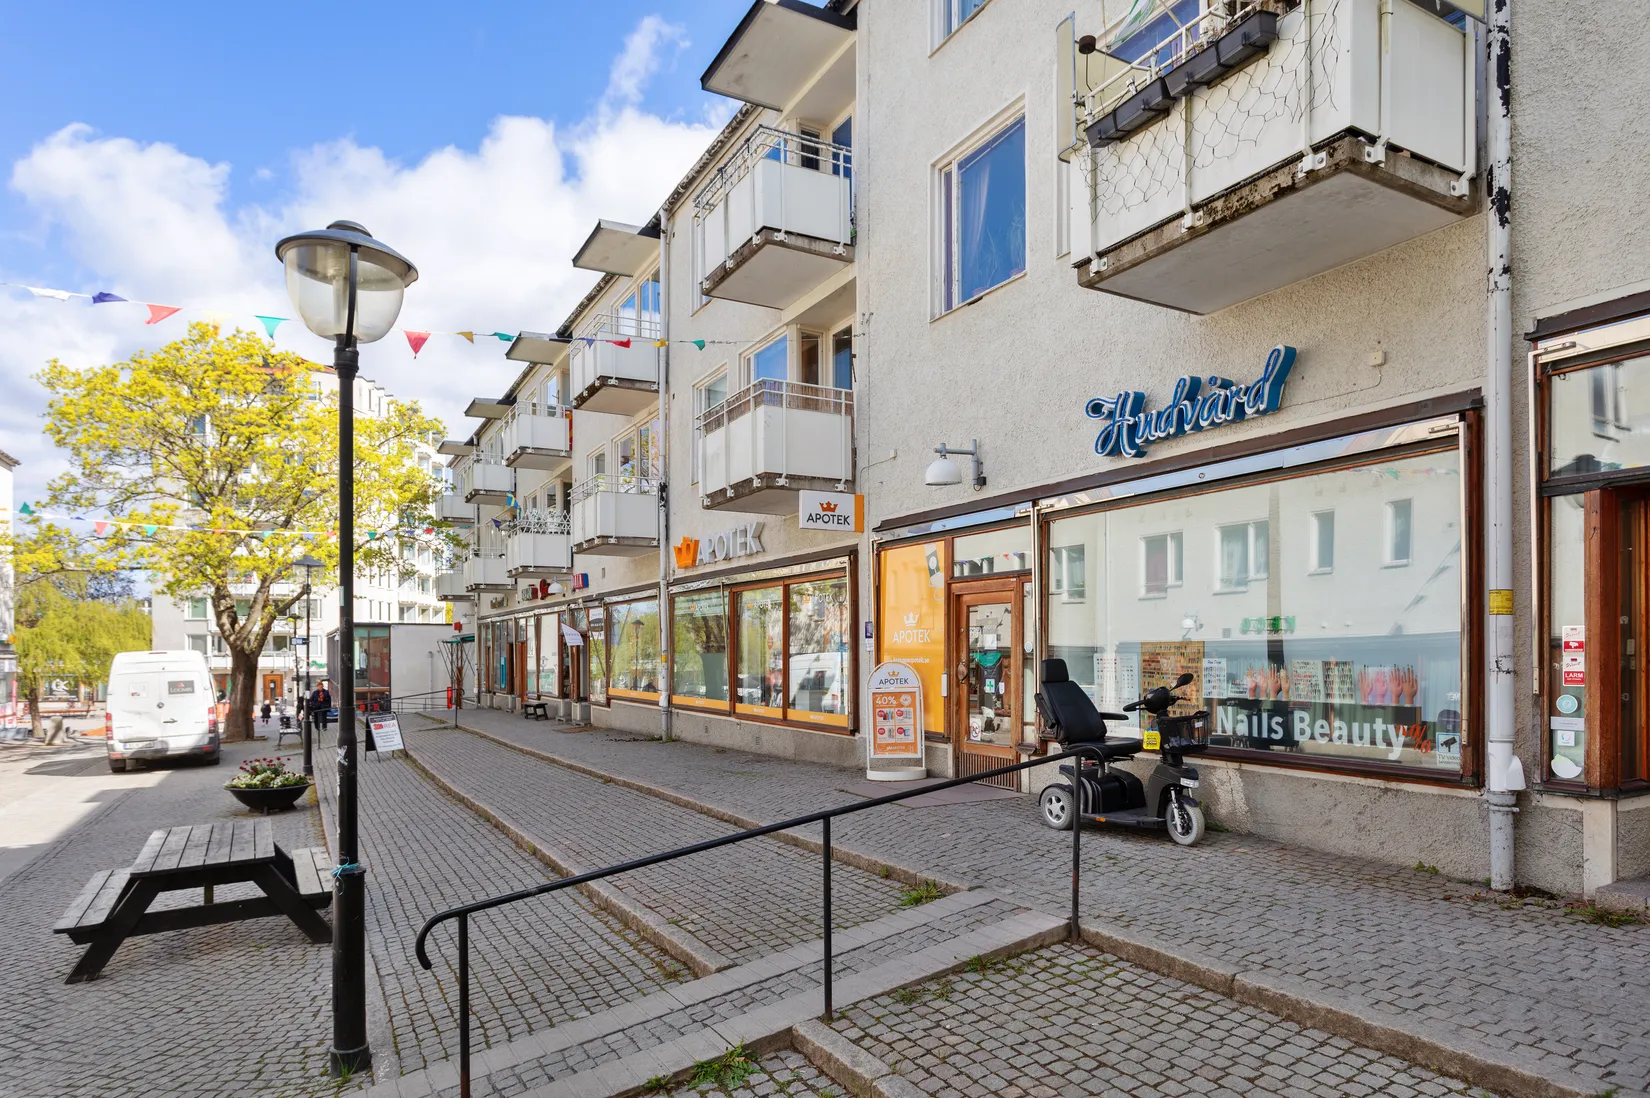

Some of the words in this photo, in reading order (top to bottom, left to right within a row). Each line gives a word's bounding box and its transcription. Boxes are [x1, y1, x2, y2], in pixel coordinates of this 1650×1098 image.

[1085, 345, 1297, 458] Hudvård
[806, 512, 851, 526] APOTEK
[696, 521, 765, 566] APOTEK
[892, 628, 931, 644] APOTEK
[879, 677, 909, 686] APOTEK
[875, 695, 897, 705] 40%
[1217, 705, 1284, 740] Nails
[1293, 710, 1408, 760] Beauty
